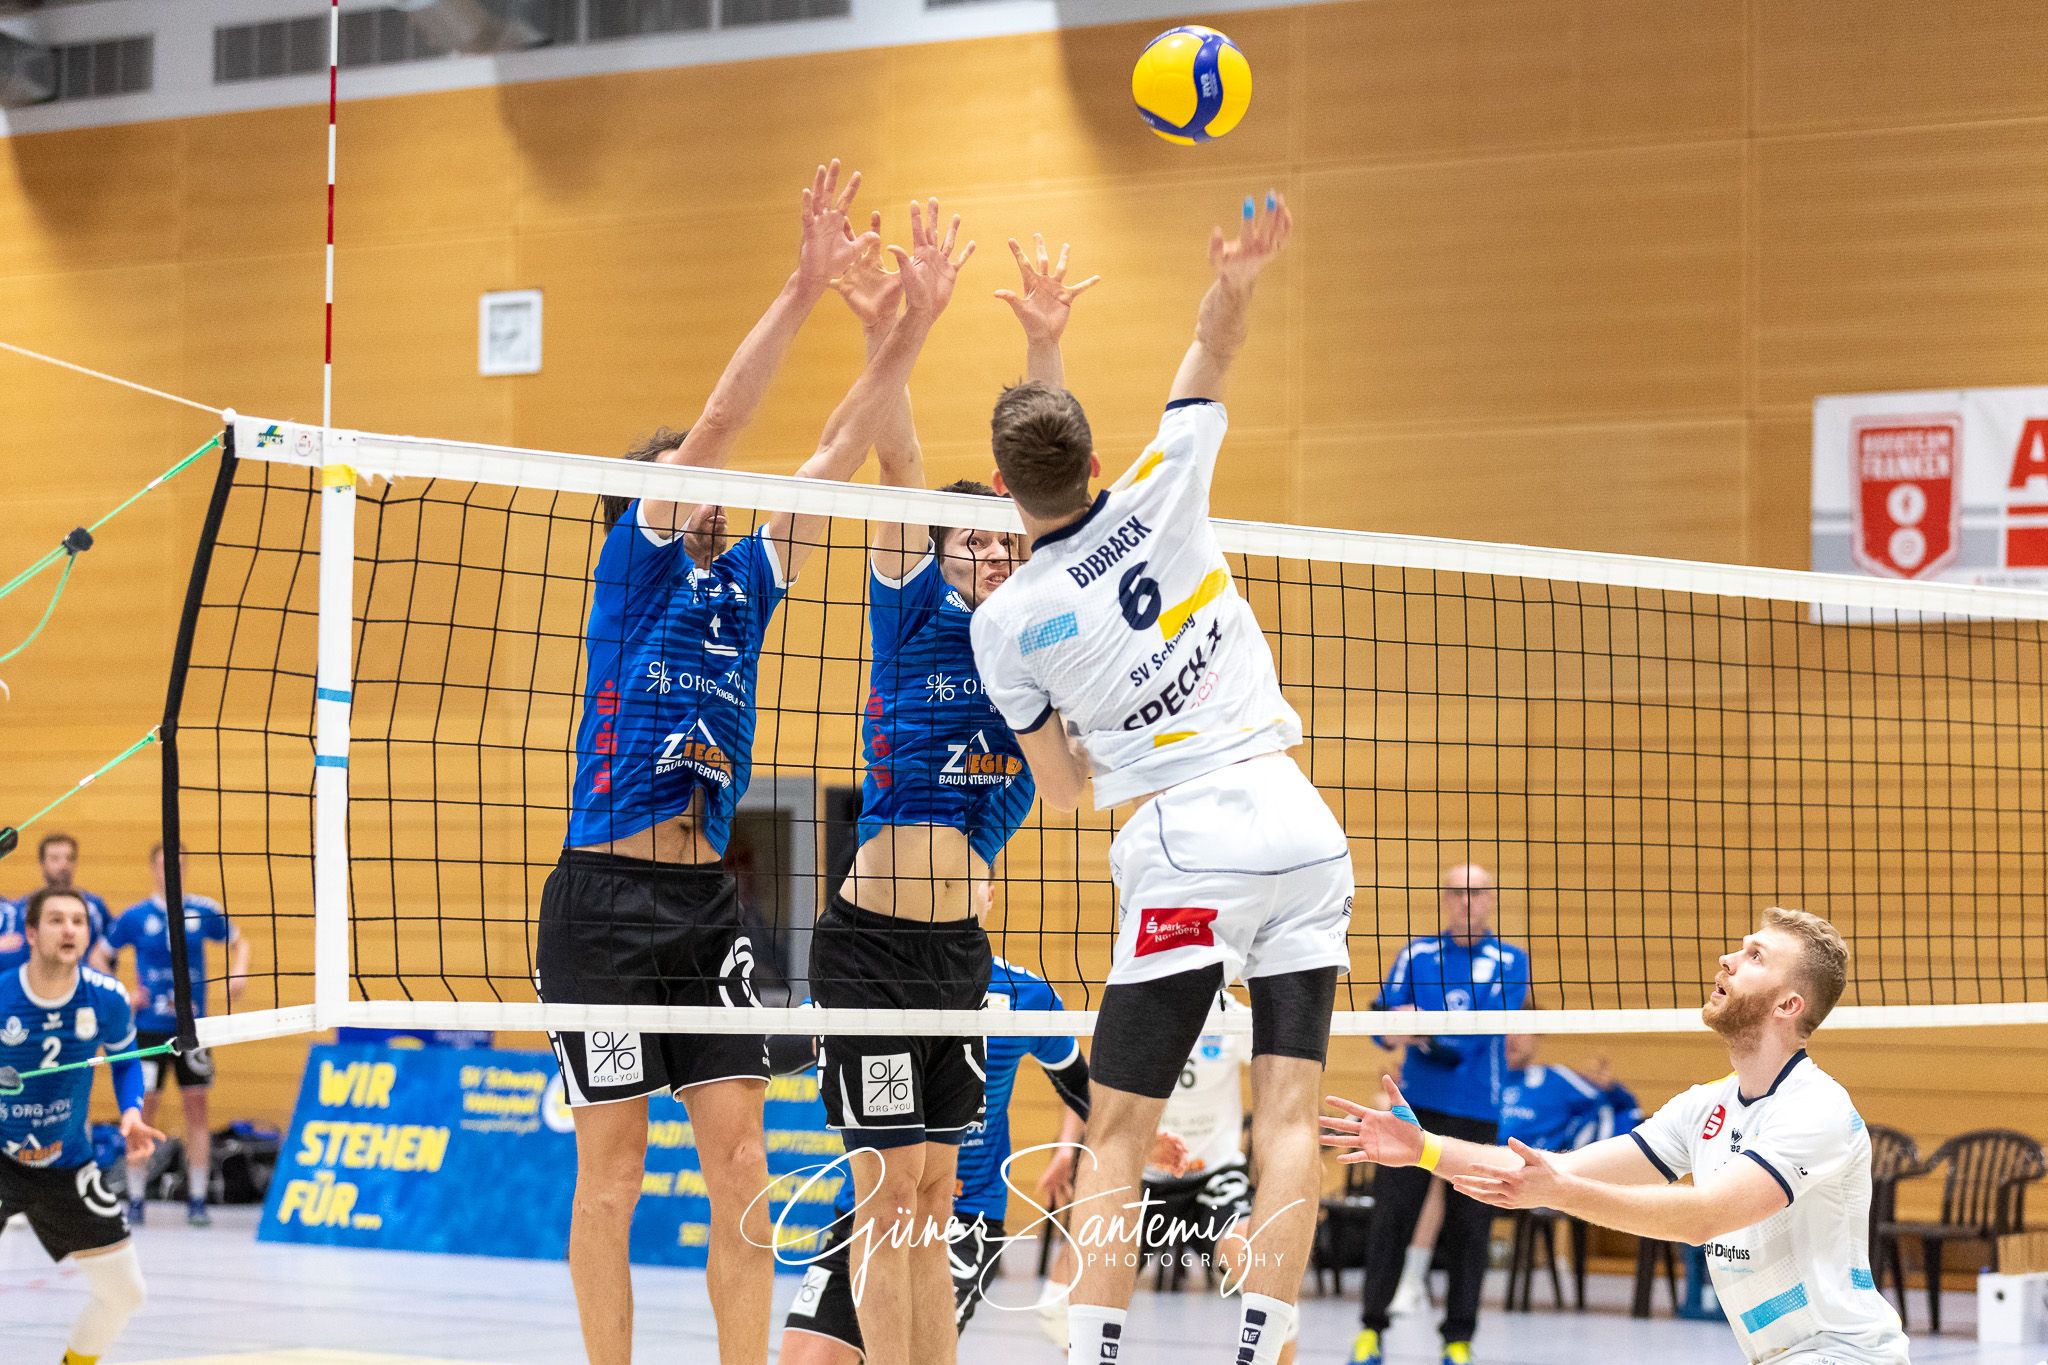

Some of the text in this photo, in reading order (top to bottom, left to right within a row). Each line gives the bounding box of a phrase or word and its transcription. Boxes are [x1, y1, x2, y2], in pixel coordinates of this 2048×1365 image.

[1066, 515, 1152, 589] BIBRACK
[1118, 560, 1162, 631] 6
[1130, 663, 1151, 688] SV
[39, 1035, 62, 1069] 2
[318, 1059, 397, 1108] WIR
[593, 1072, 640, 1083] ORG-YOU
[868, 1103, 911, 1113] ORG-YOU
[295, 1120, 450, 1172] STEHEN
